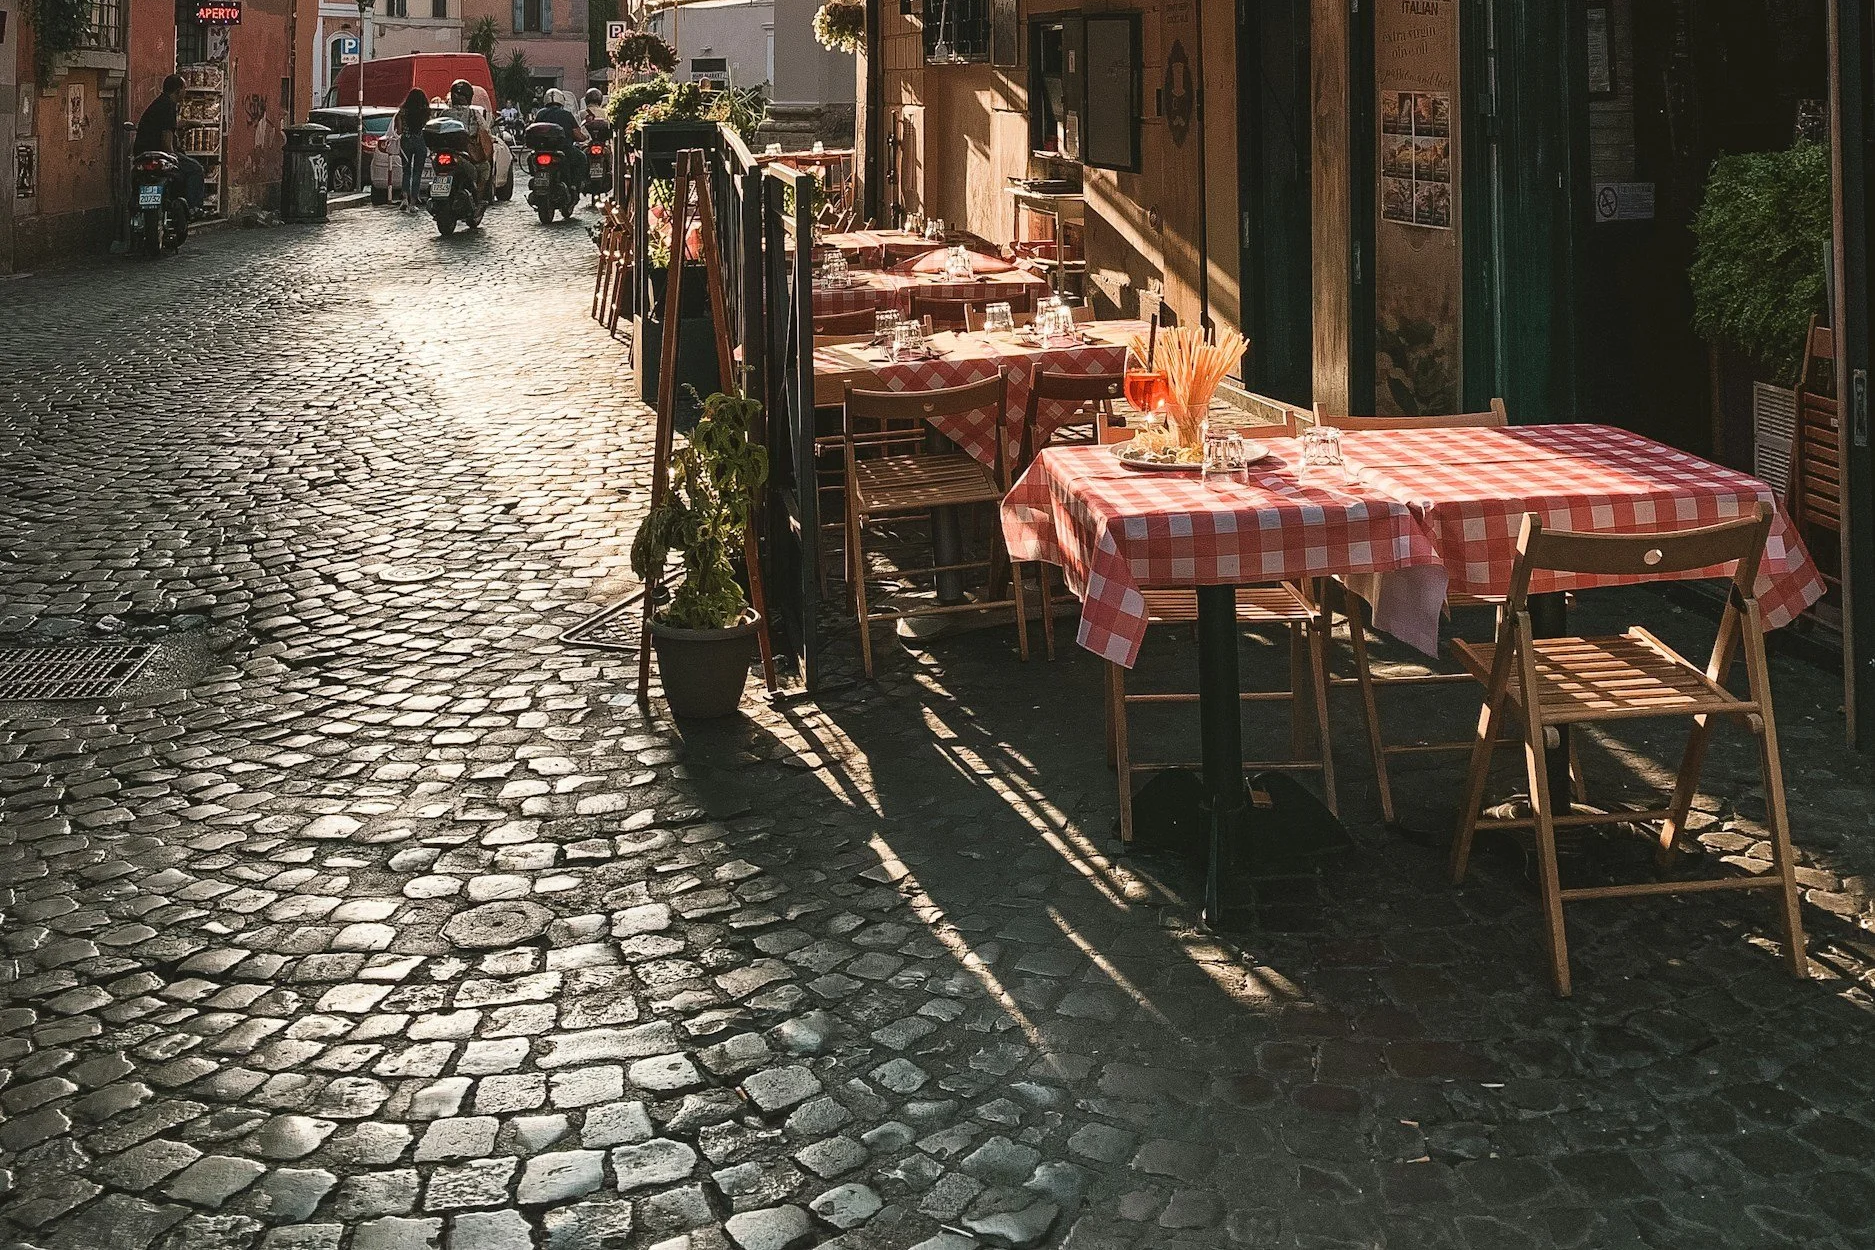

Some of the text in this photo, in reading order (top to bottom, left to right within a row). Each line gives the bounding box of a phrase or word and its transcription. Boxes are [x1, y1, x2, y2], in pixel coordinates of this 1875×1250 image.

[198, 7, 239, 19] APERTO
[1401, 0, 1439, 17] ITALIAN
[611, 25, 622, 38] P
[1382, 24, 1437, 43] extra virgin
[344, 39, 357, 54] P
[1391, 44, 1414, 59] olive
